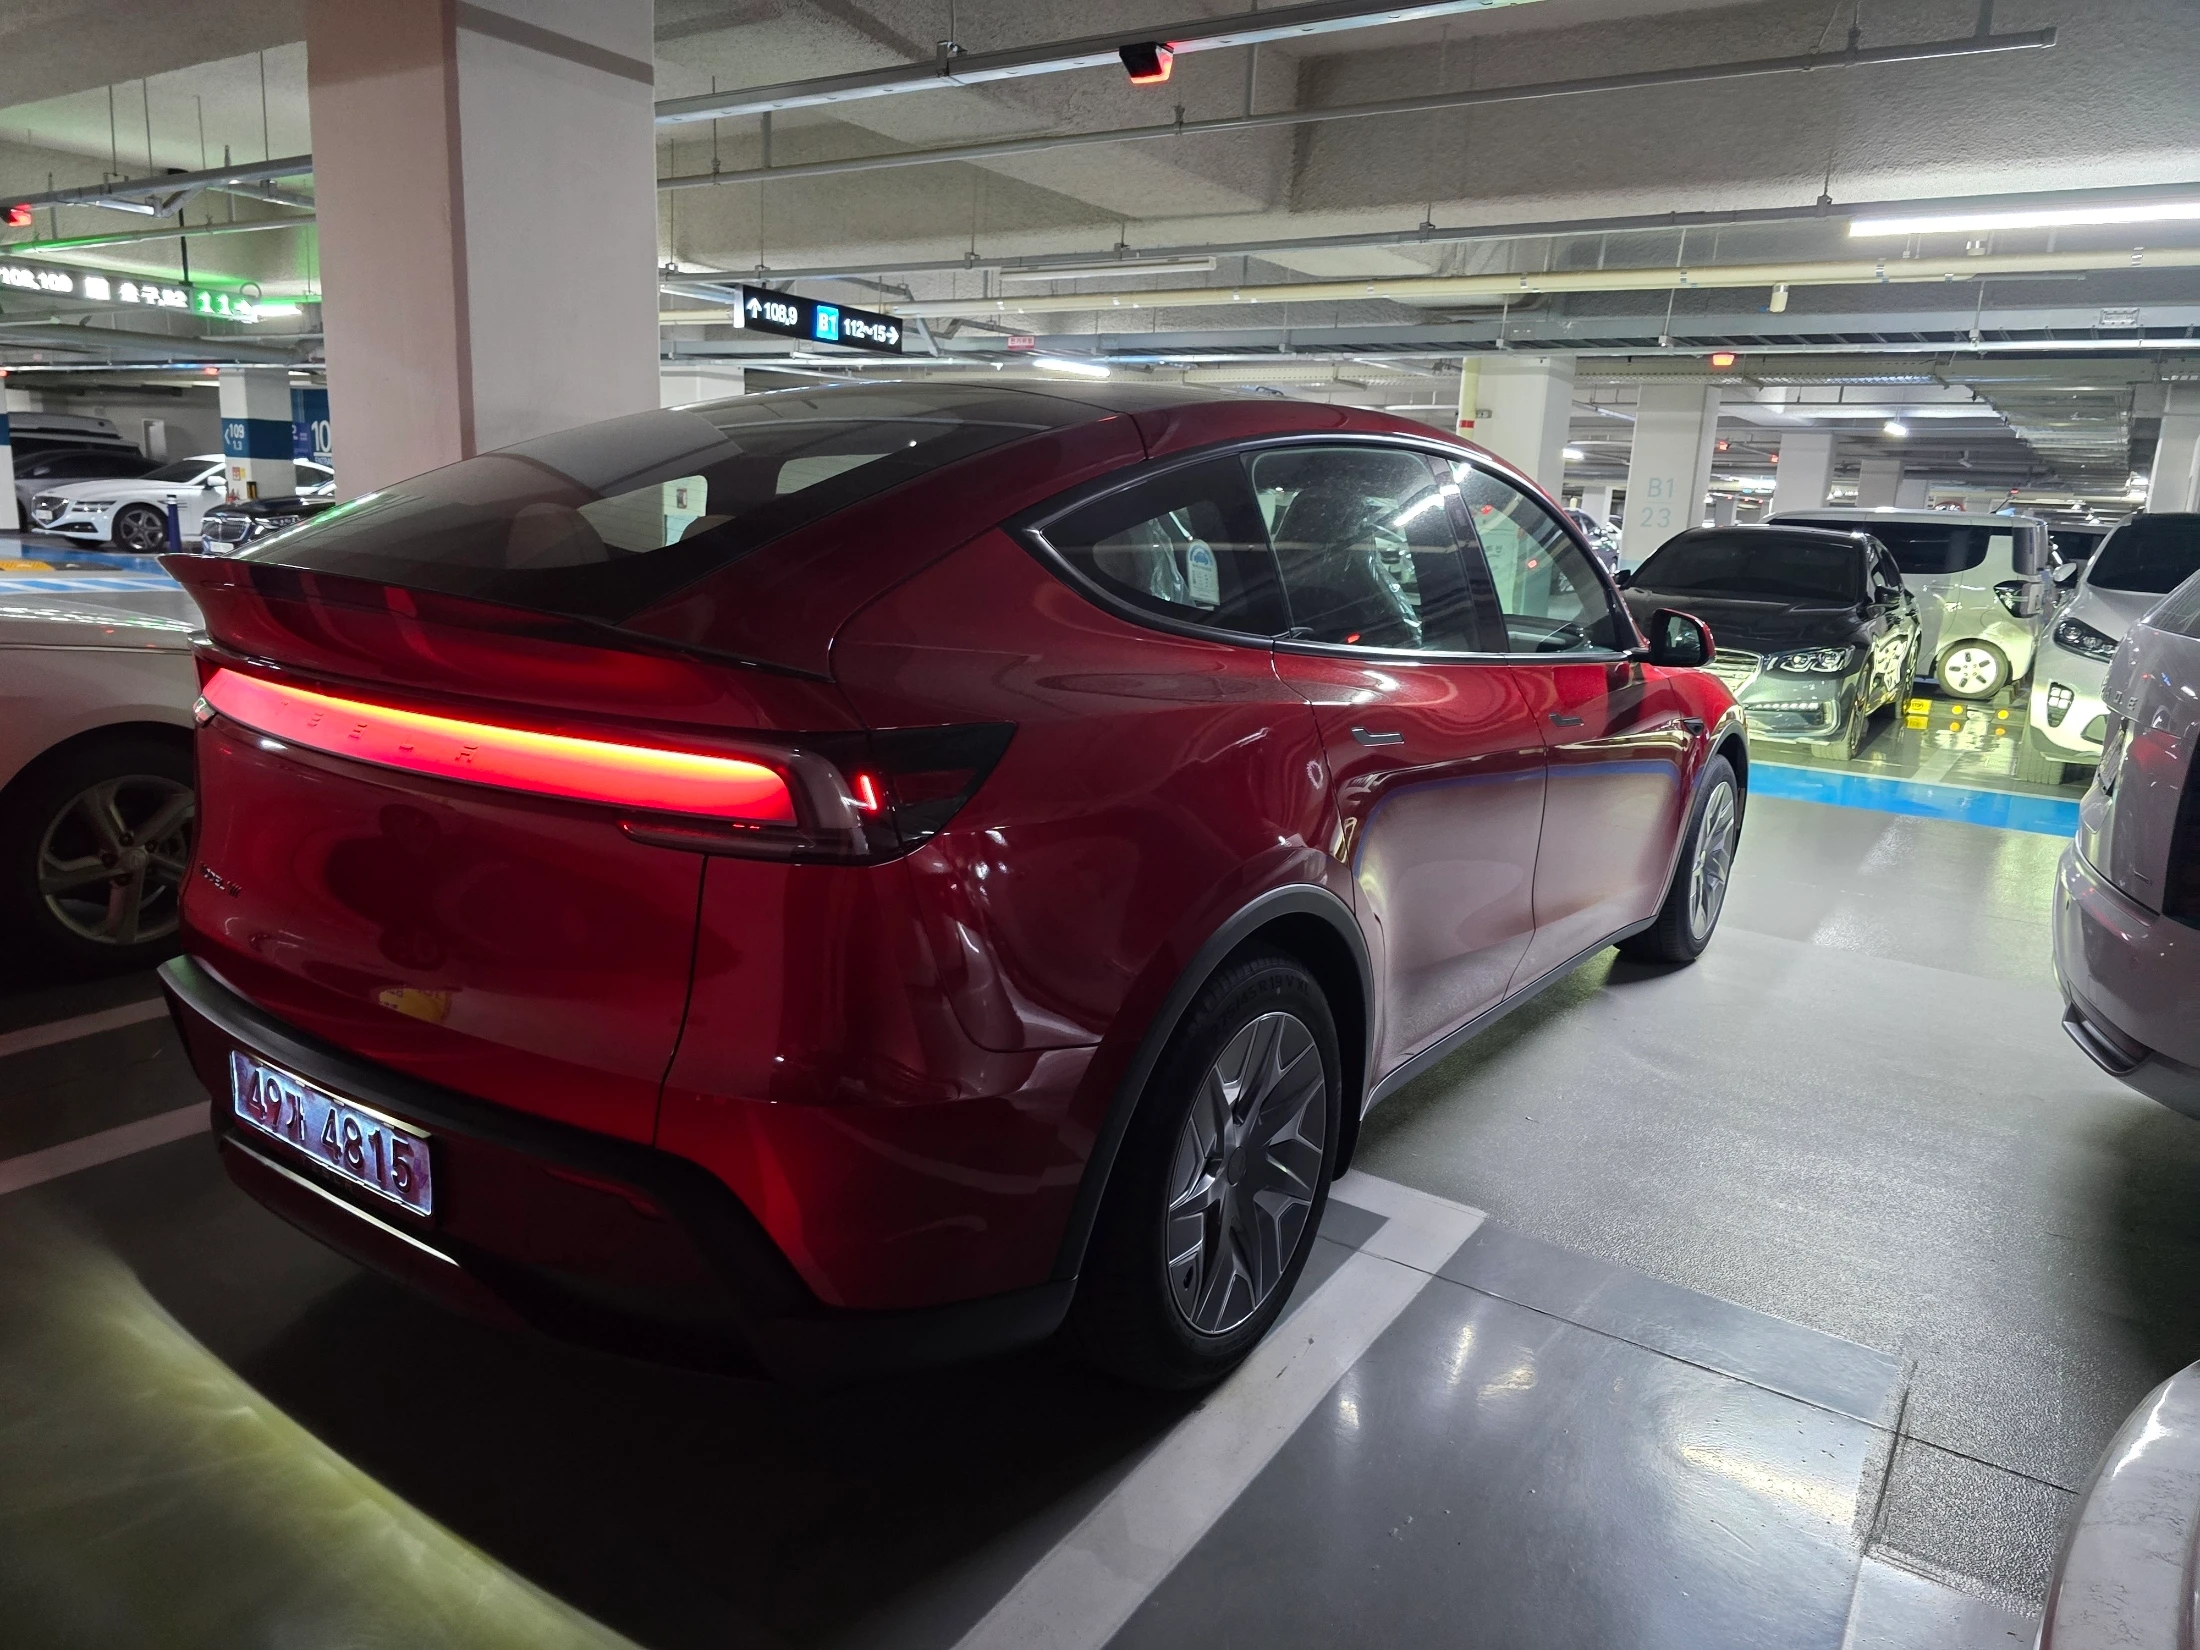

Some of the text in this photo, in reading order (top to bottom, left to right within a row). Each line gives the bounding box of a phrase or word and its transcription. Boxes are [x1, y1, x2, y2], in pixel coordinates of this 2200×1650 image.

[763, 302, 798, 326] 108,9
[818, 312, 837, 333] B1
[229, 423, 245, 439] 109
[311, 420, 332, 453] 10
[1648, 477, 1674, 498] B1
[1640, 507, 1672, 528] 23
[275, 699, 479, 764] TESLA
[249, 1067, 415, 1195] 49가 4815
